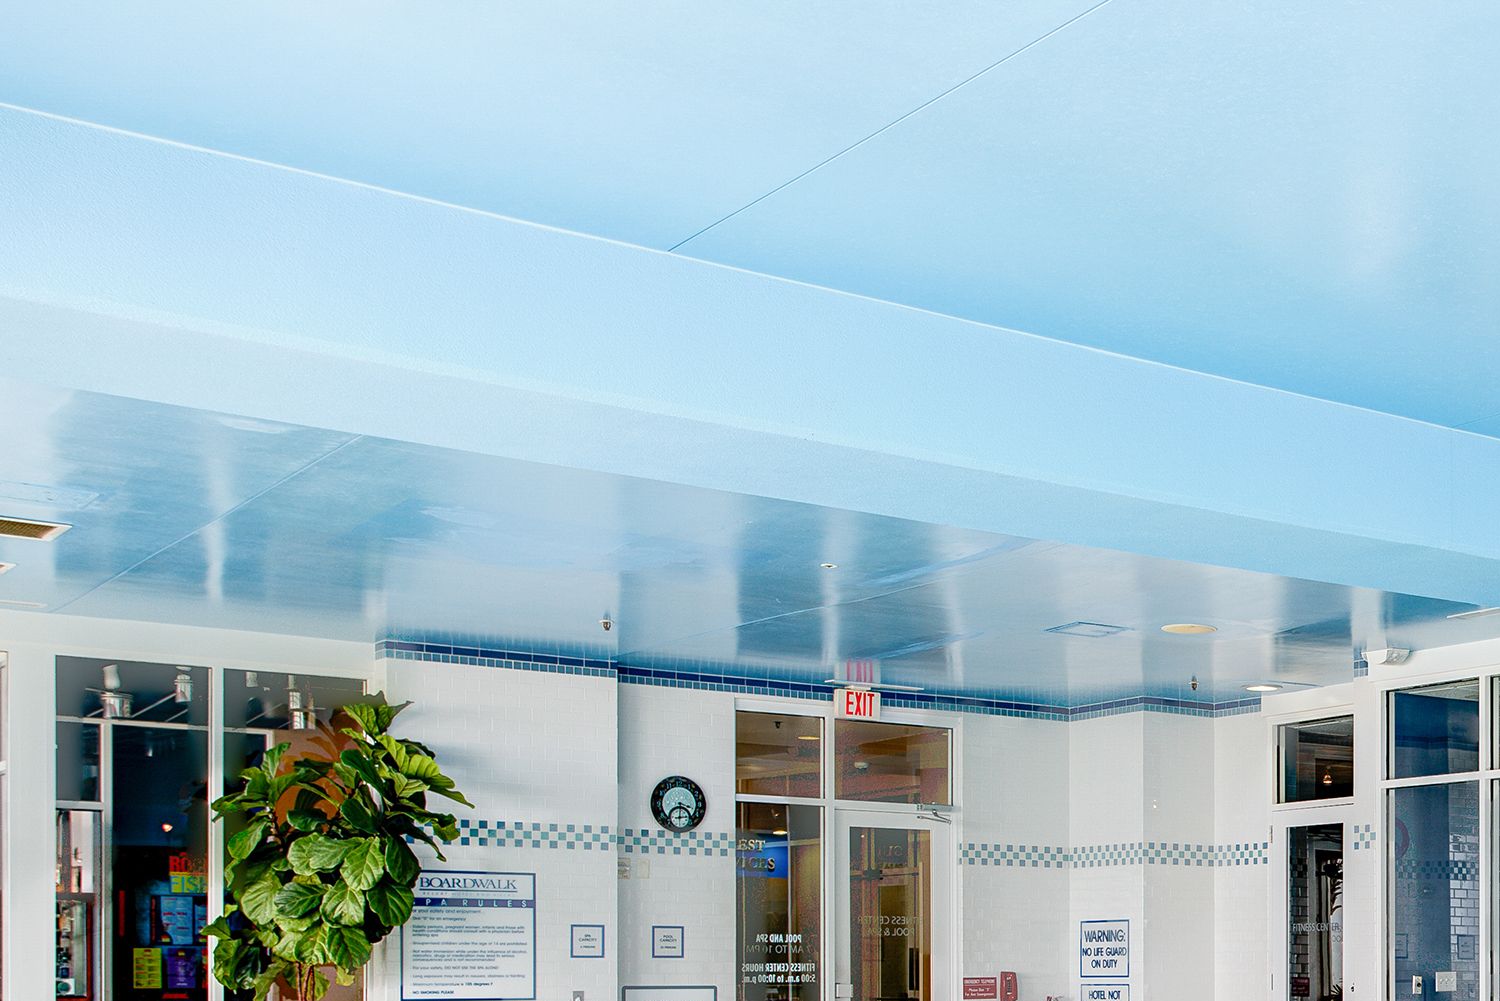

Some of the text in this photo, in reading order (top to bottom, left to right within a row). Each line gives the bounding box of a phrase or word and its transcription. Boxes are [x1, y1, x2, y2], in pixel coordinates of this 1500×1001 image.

[846, 691, 874, 716] EXIT
[738, 838, 766, 851] EST
[420, 877, 516, 889] BOARDWALK
[462, 899, 527, 907] RULES
[1293, 923, 1316, 932] FITNESS
[1084, 930, 1126, 943] WARNING:
[1082, 947, 1127, 956] NO LIFE GUARD
[1091, 960, 1118, 968] ON DUTY
[1089, 990, 1121, 1000] HOTEL NOT
